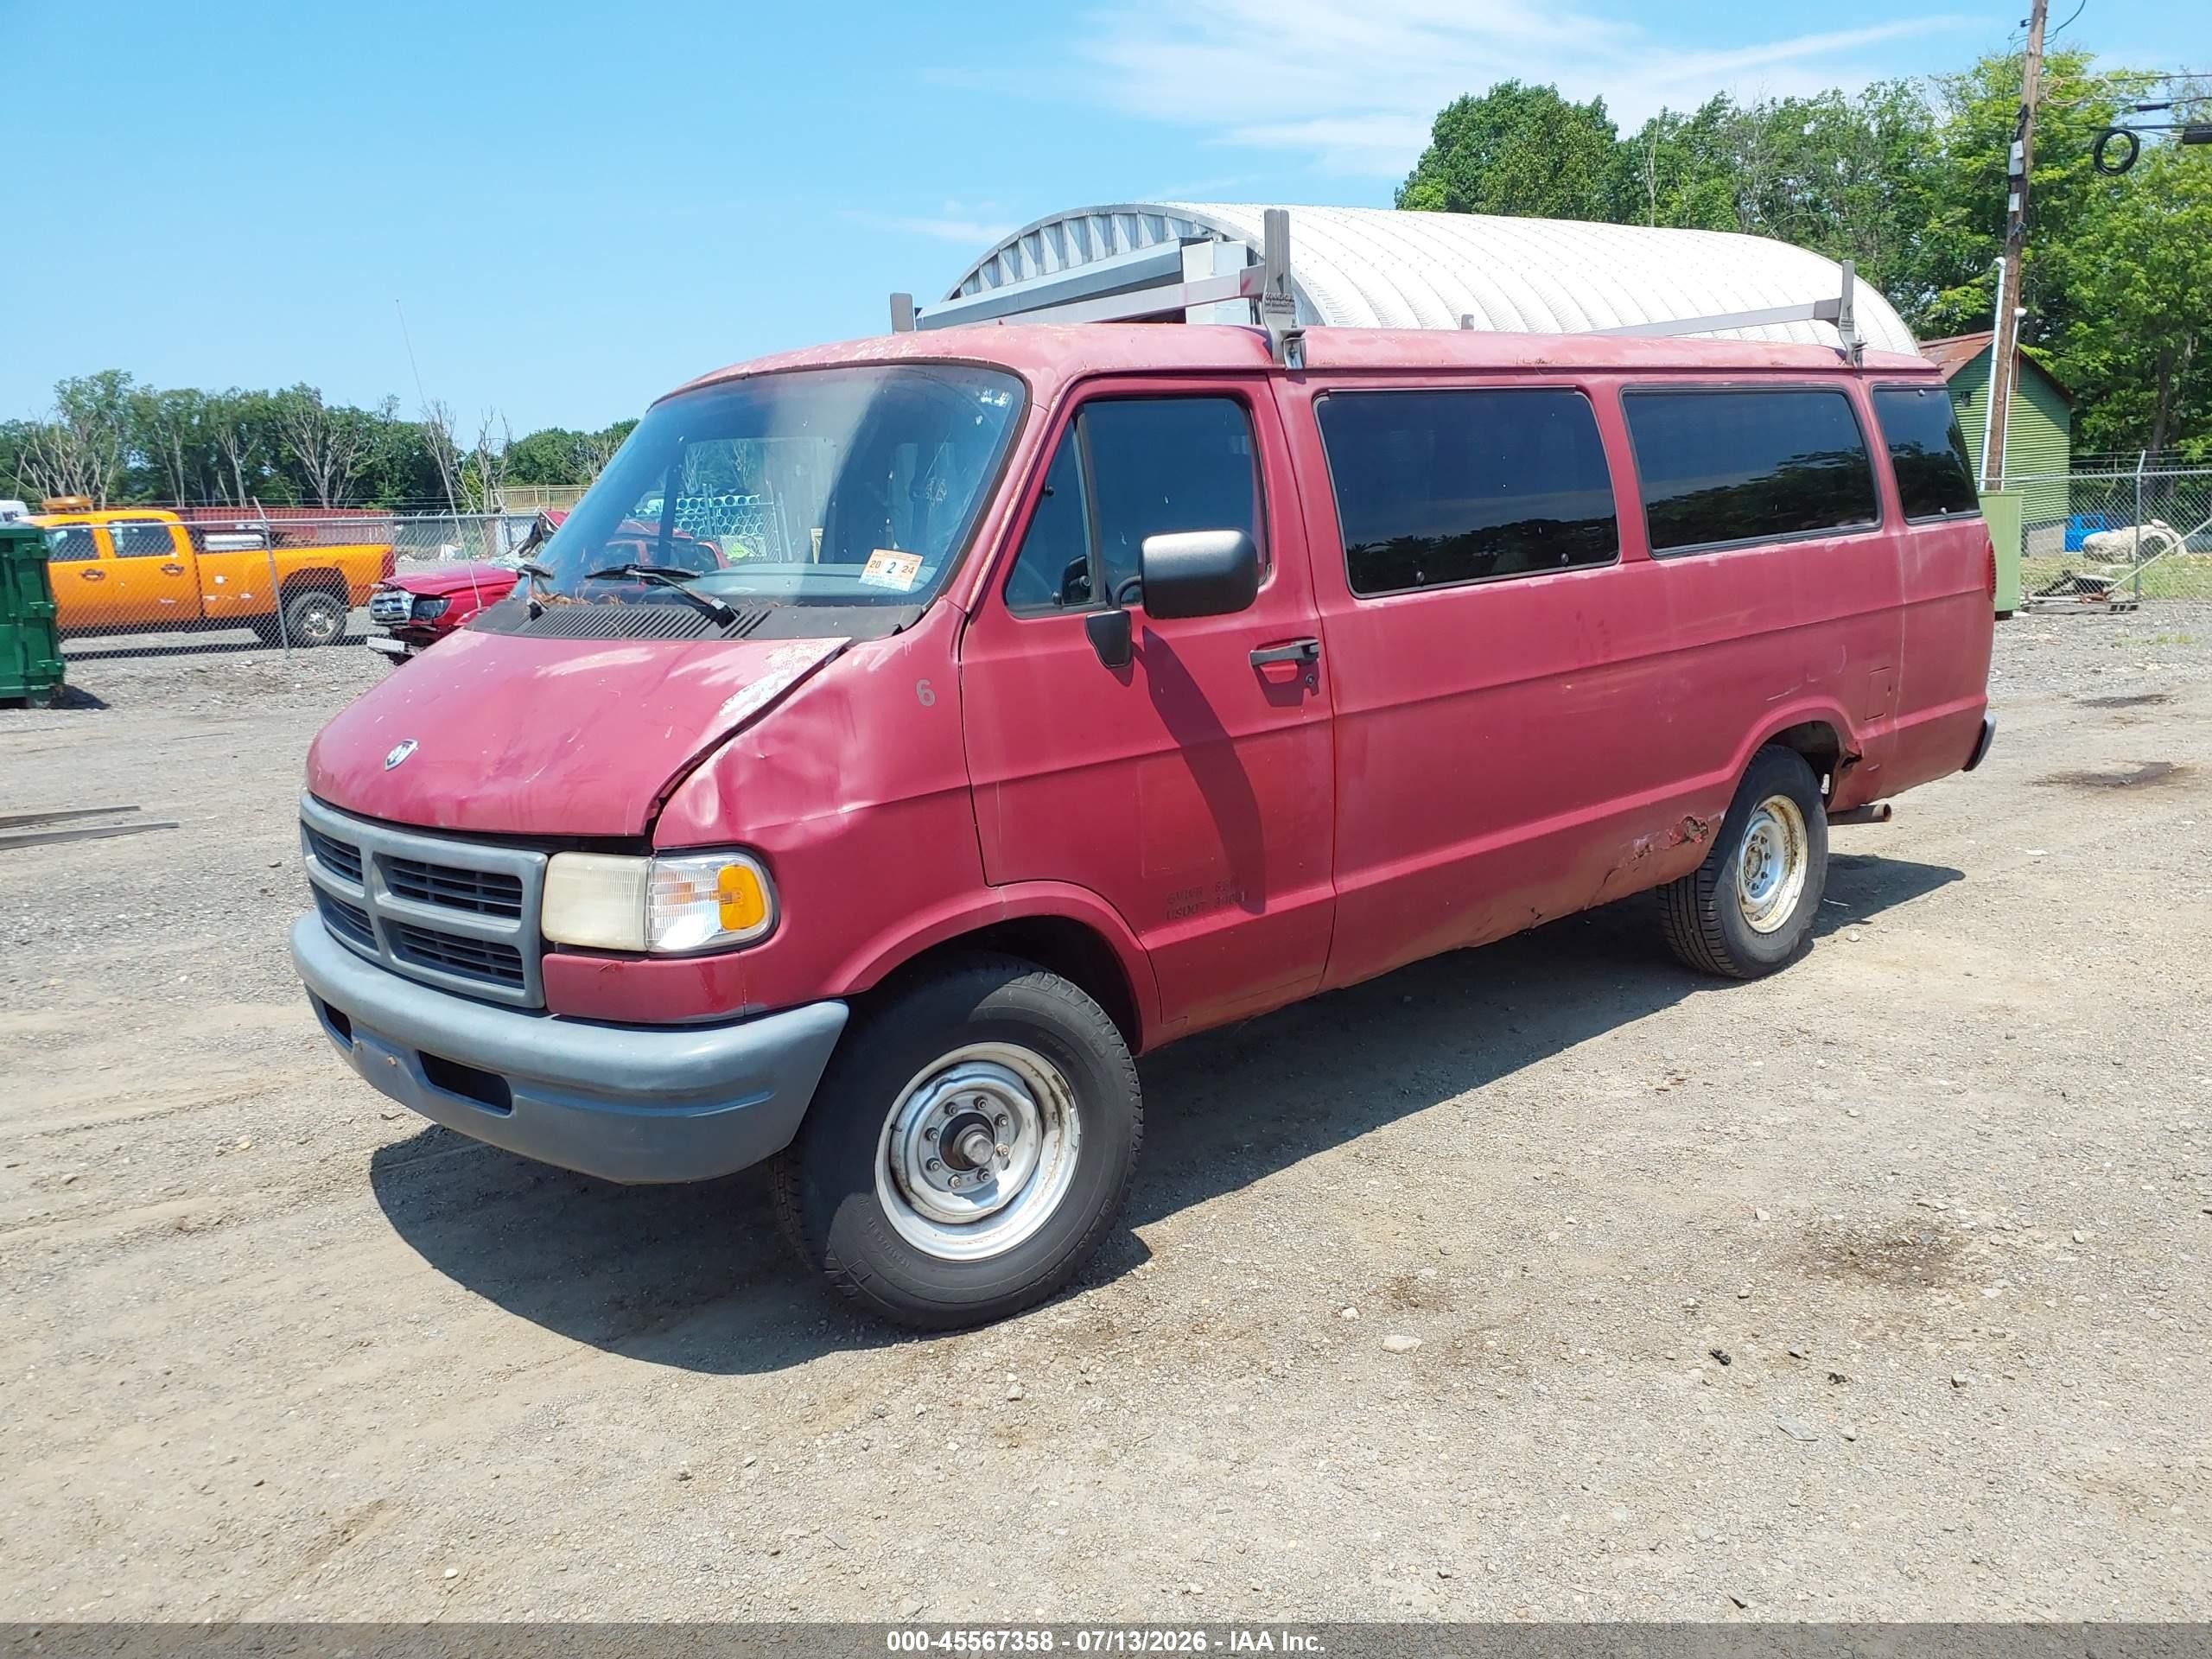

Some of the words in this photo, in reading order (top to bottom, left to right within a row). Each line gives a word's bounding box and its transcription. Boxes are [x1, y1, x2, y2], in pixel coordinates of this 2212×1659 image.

[869, 560, 882, 569] 20
[886, 562, 897, 574] 2
[901, 565, 915, 575] 24
[916, 678, 936, 707] 6
